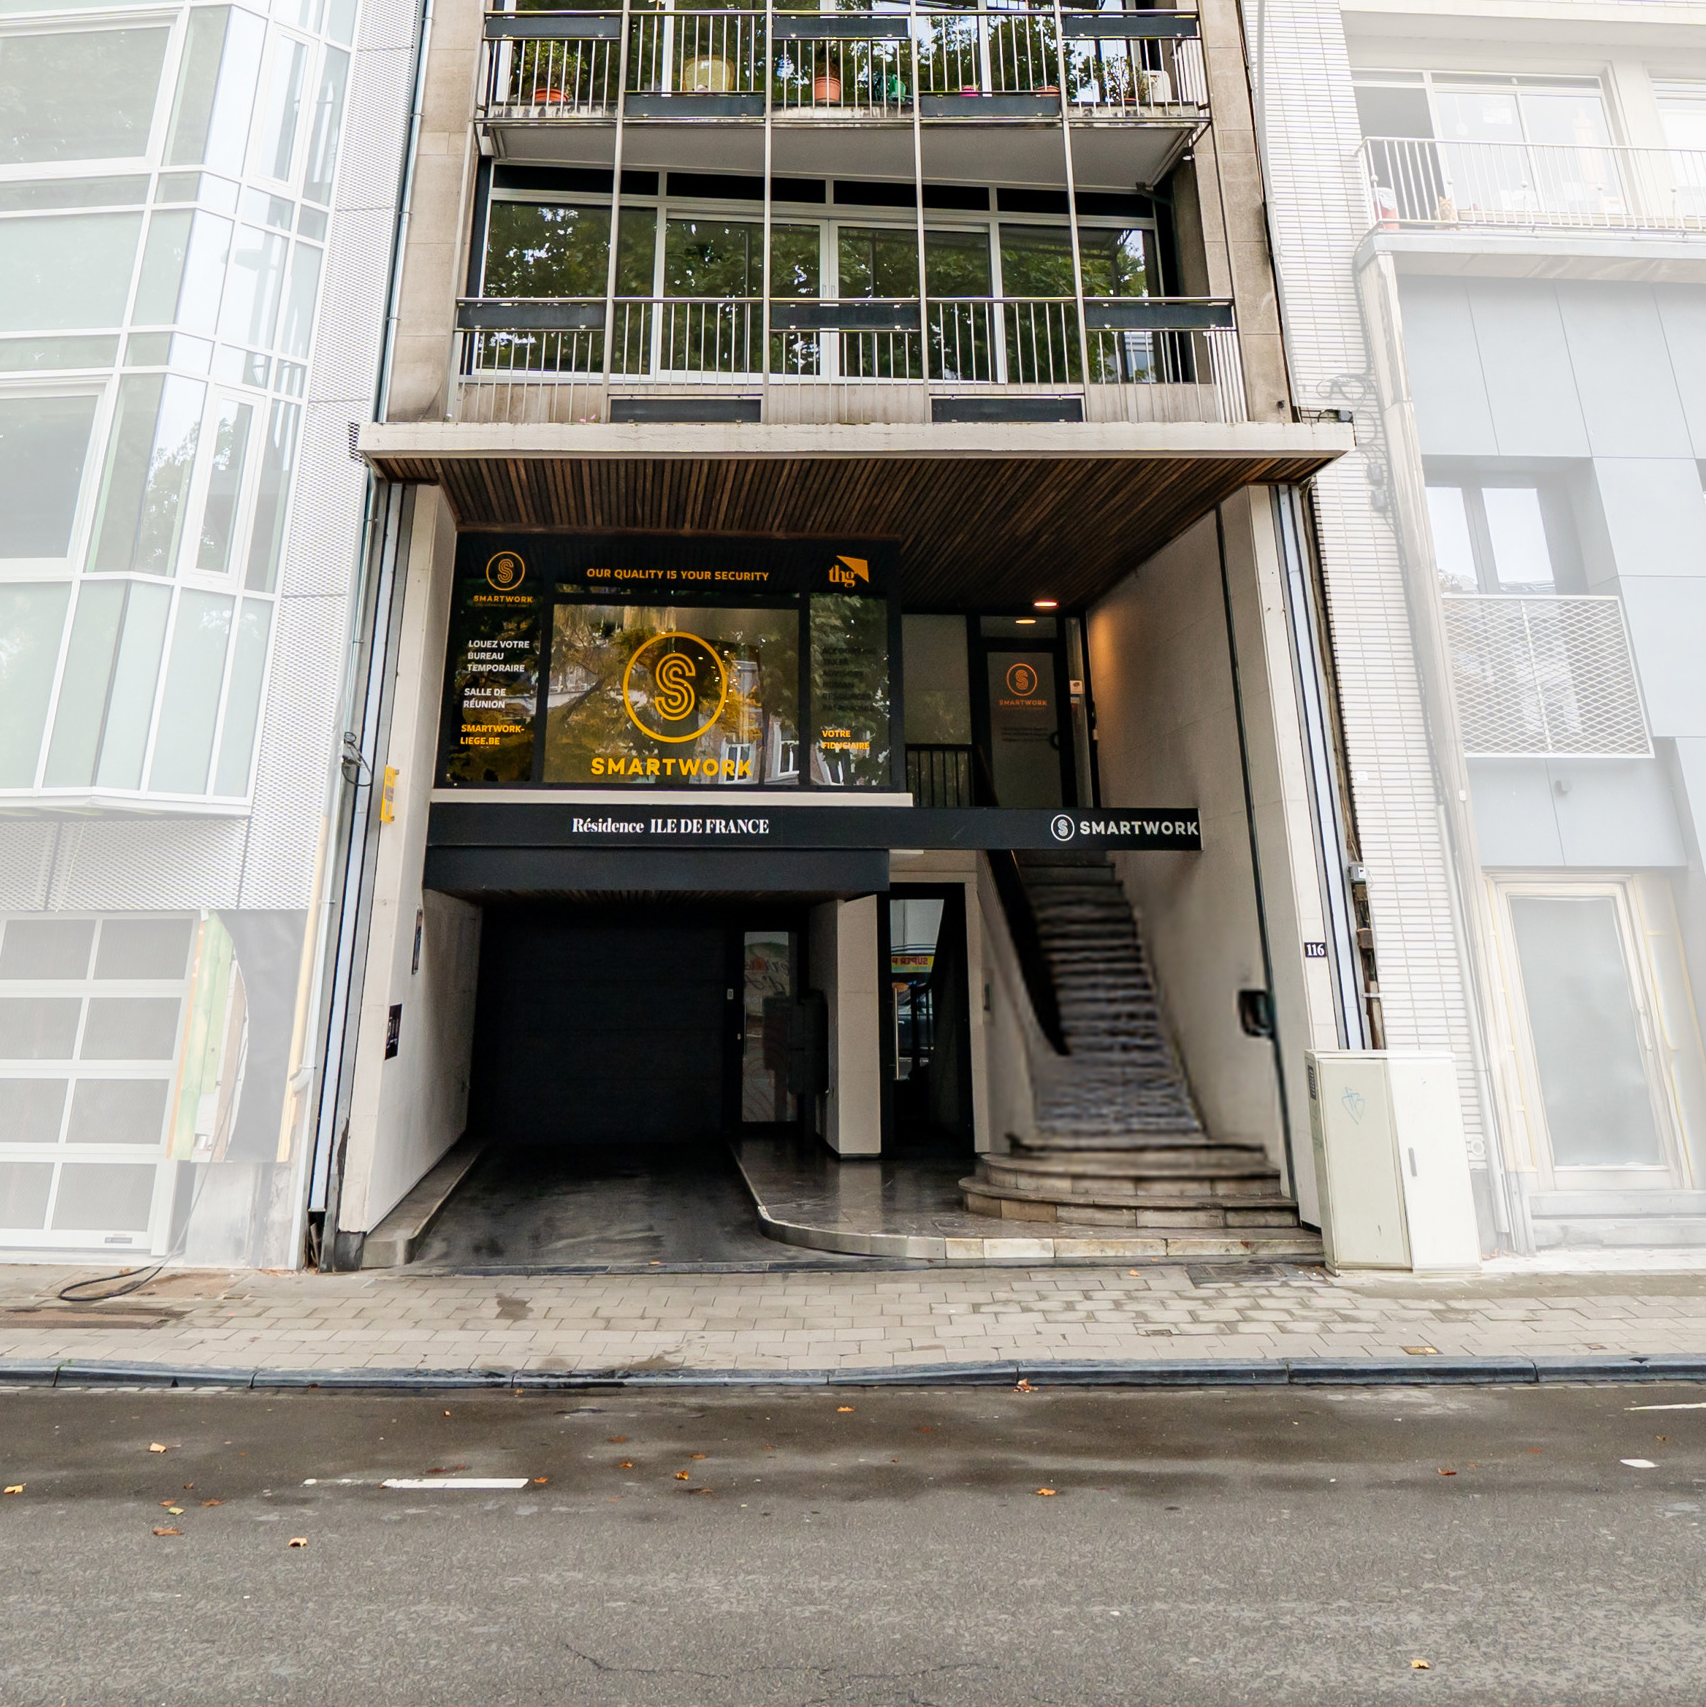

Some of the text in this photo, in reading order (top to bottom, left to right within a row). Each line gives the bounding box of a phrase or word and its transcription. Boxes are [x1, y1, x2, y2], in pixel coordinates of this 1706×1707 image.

[586, 568, 769, 582] OUR QUALITY IS YOUR SECURITY
[829, 564, 856, 588] thg
[473, 595, 533, 603] SMARTWORK
[468, 640, 498, 648] LOUEZ
[467, 652, 504, 660] BUREAU
[467, 664, 526, 672] TEMPORAIRE
[464, 688, 506, 696] SALLE DE
[463, 697, 505, 708] RÉUNION
[461, 724, 525, 733] SMARTWORK-
[460, 737, 500, 745] LIEGE.BE
[821, 741, 870, 750] FIDUCIAIRE
[591, 757, 753, 776] SMARTWORK
[572, 817, 769, 833] Résidence ILE DE FRANCE
[1079, 821, 1199, 835] SMARTWORK
[1306, 944, 1325, 956] 116
